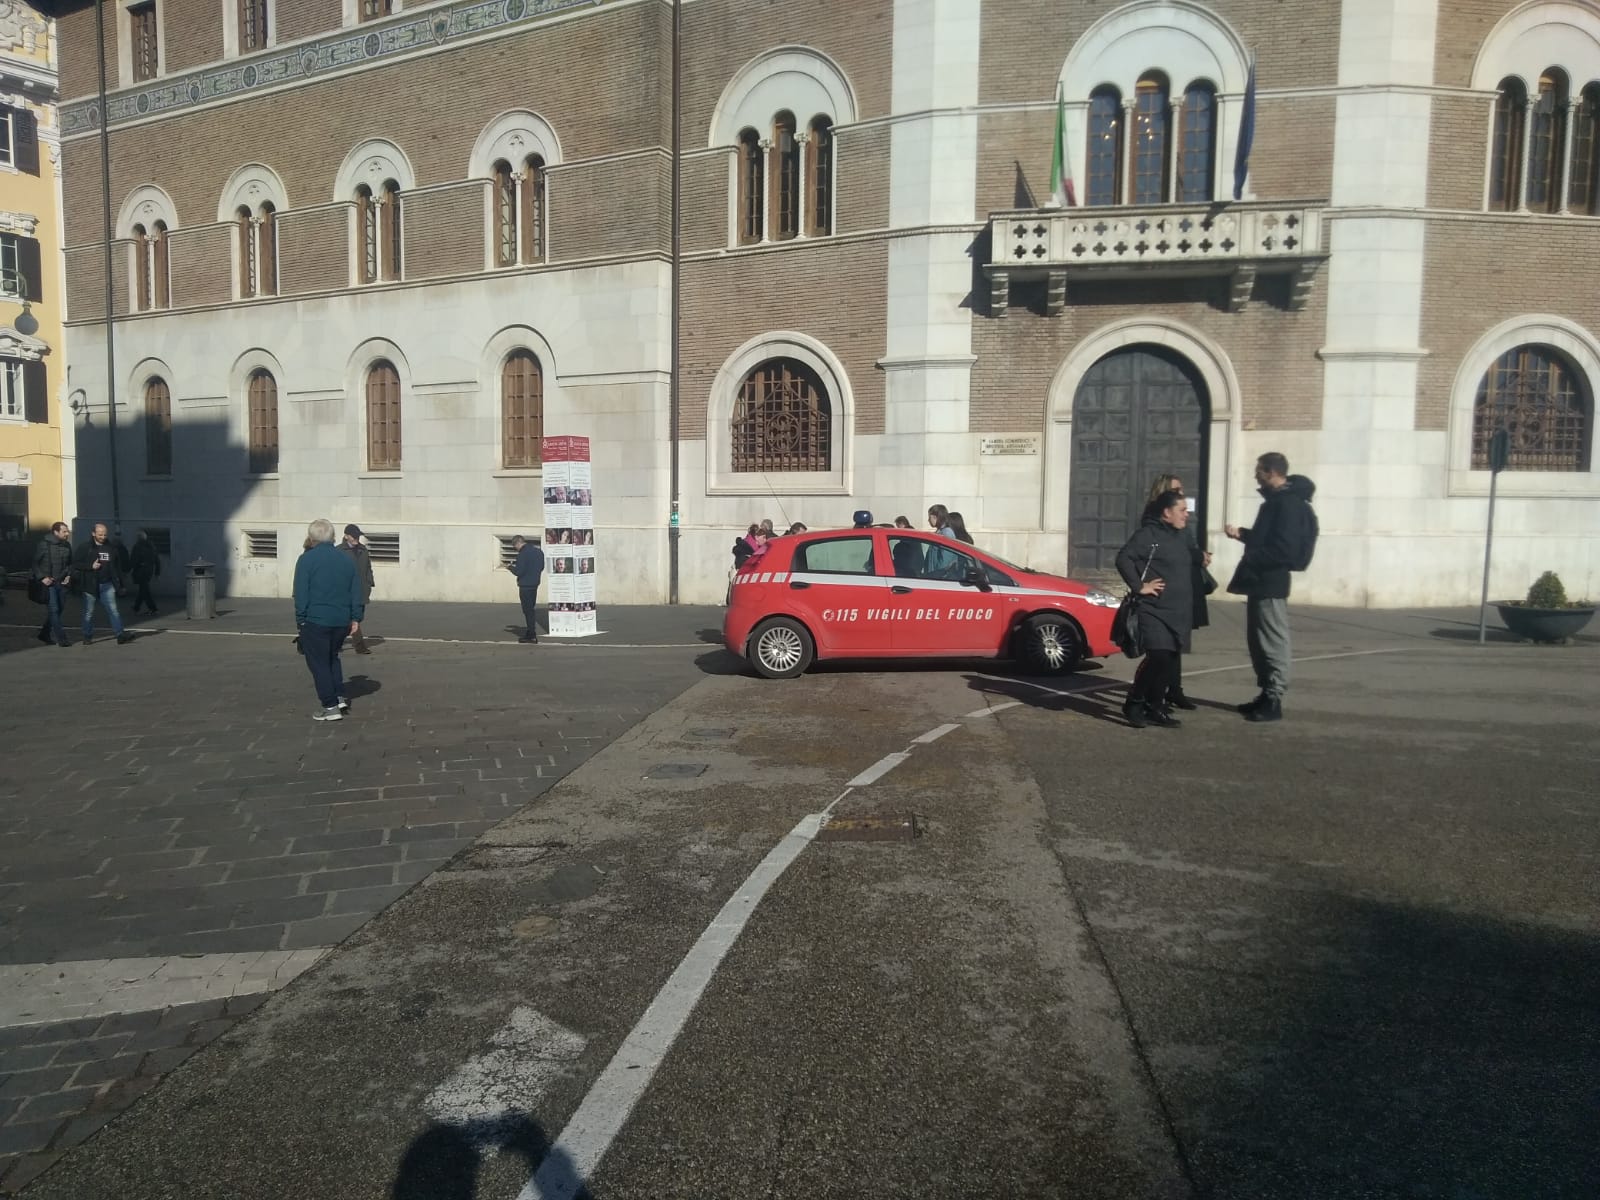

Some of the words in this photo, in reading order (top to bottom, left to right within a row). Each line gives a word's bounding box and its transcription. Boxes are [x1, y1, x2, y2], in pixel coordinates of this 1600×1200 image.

[836, 608, 858, 622] 115
[866, 608, 911, 620] VIGILI
[915, 608, 941, 620] DEL
[948, 608, 993, 620] FUOCO
